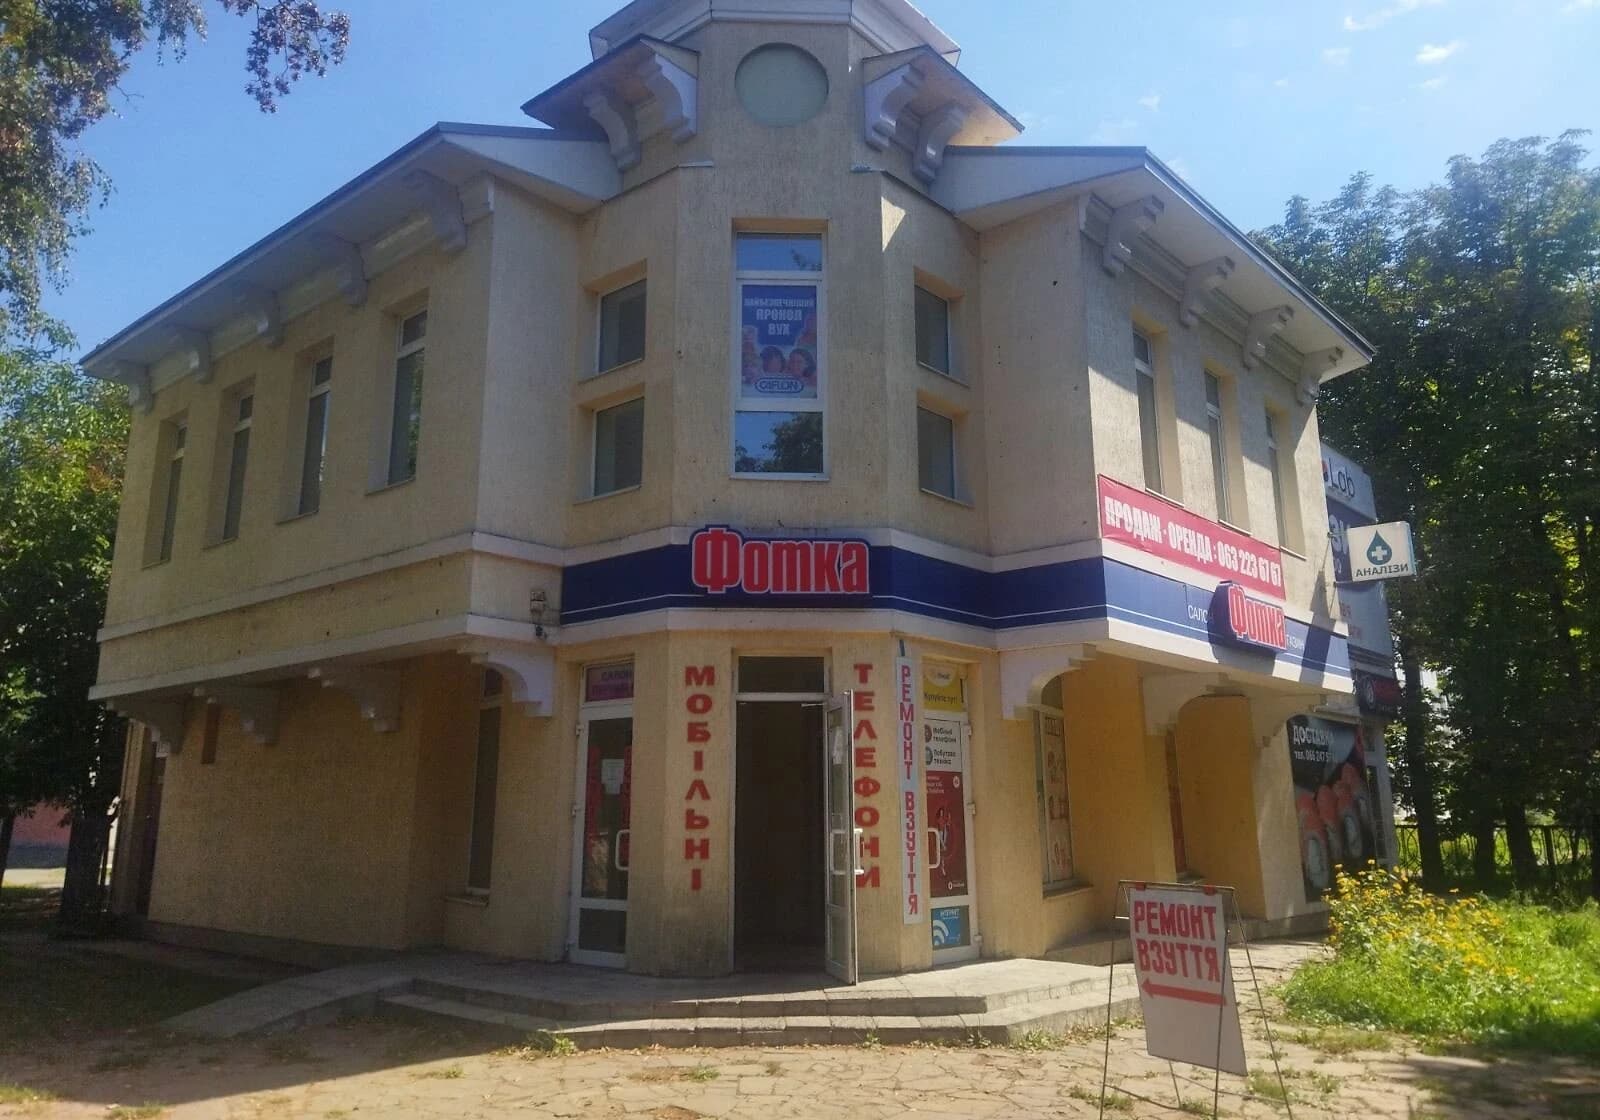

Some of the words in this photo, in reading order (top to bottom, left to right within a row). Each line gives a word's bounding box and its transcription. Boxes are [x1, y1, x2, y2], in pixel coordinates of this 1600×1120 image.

[768, 323, 790, 336] ВУХ
[692, 528, 869, 594] Фотка
[1104, 496, 1163, 544] ПРОДАЖ
[1217, 541, 1239, 572] 063
[1239, 549, 1259, 579] 223
[1258, 557, 1270, 584] 67
[1270, 562, 1281, 587] 67
[1355, 563, 1409, 578] АНАЛІЗИ
[900, 665, 914, 780] РЕМОНТ
[684, 665, 715, 891] МОБІЛЬНІ
[853, 664, 880, 888] ТЕЛЕФОНИ
[905, 791, 918, 915] ВЗУТТЯ
[1134, 901, 1216, 941] РЕМОНТ
[1137, 938, 1221, 983] ВЗУТТЯ
